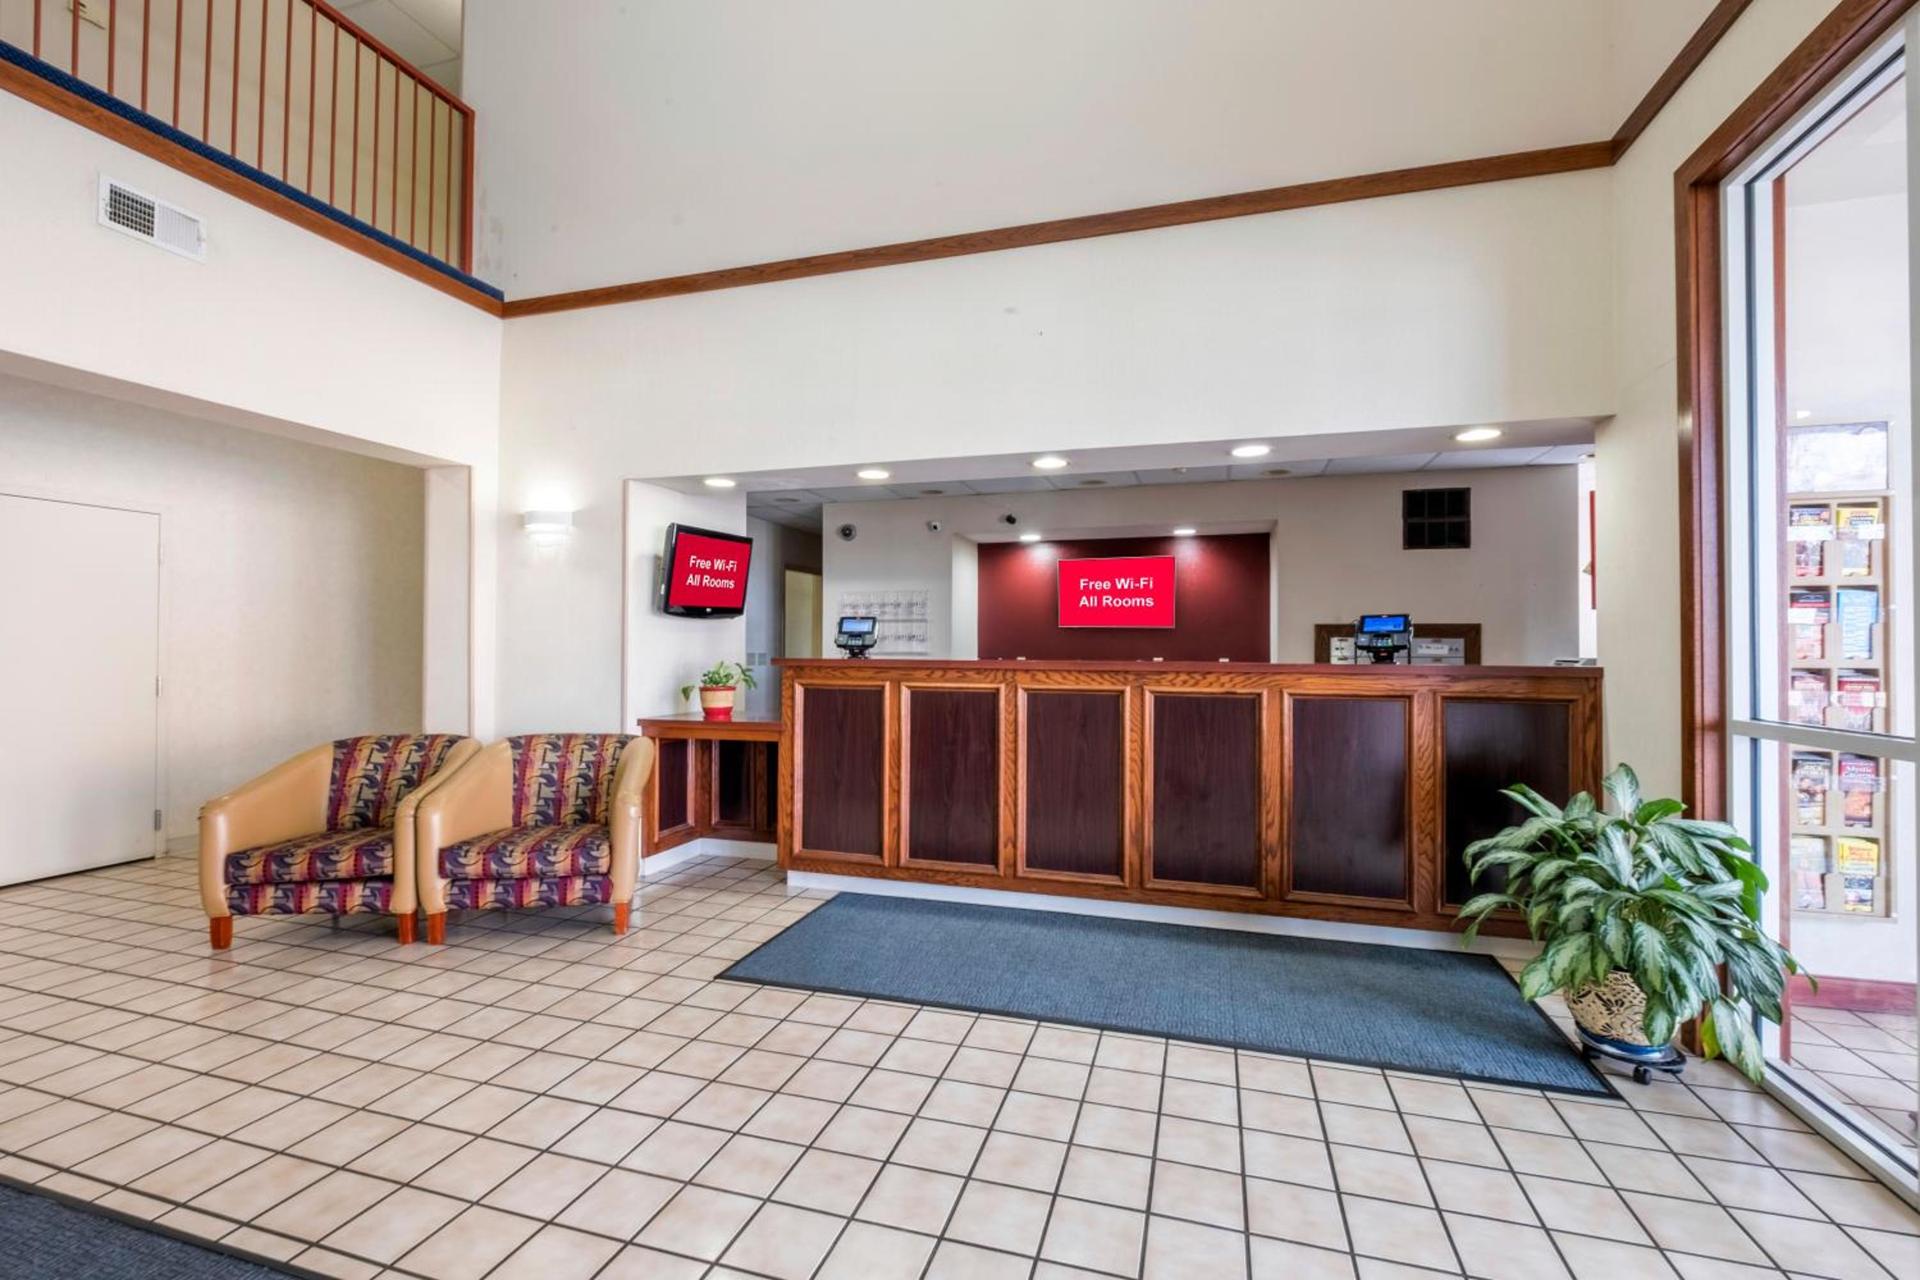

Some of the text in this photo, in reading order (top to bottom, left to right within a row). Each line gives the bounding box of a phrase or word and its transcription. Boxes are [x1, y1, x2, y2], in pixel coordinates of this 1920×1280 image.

[689, 555, 737, 572] Free Wi-Fi
[685, 573, 735, 589] All Rooms
[1079, 577, 1153, 590] Free Wi-Fi
[1079, 595, 1154, 607] All Rooms
